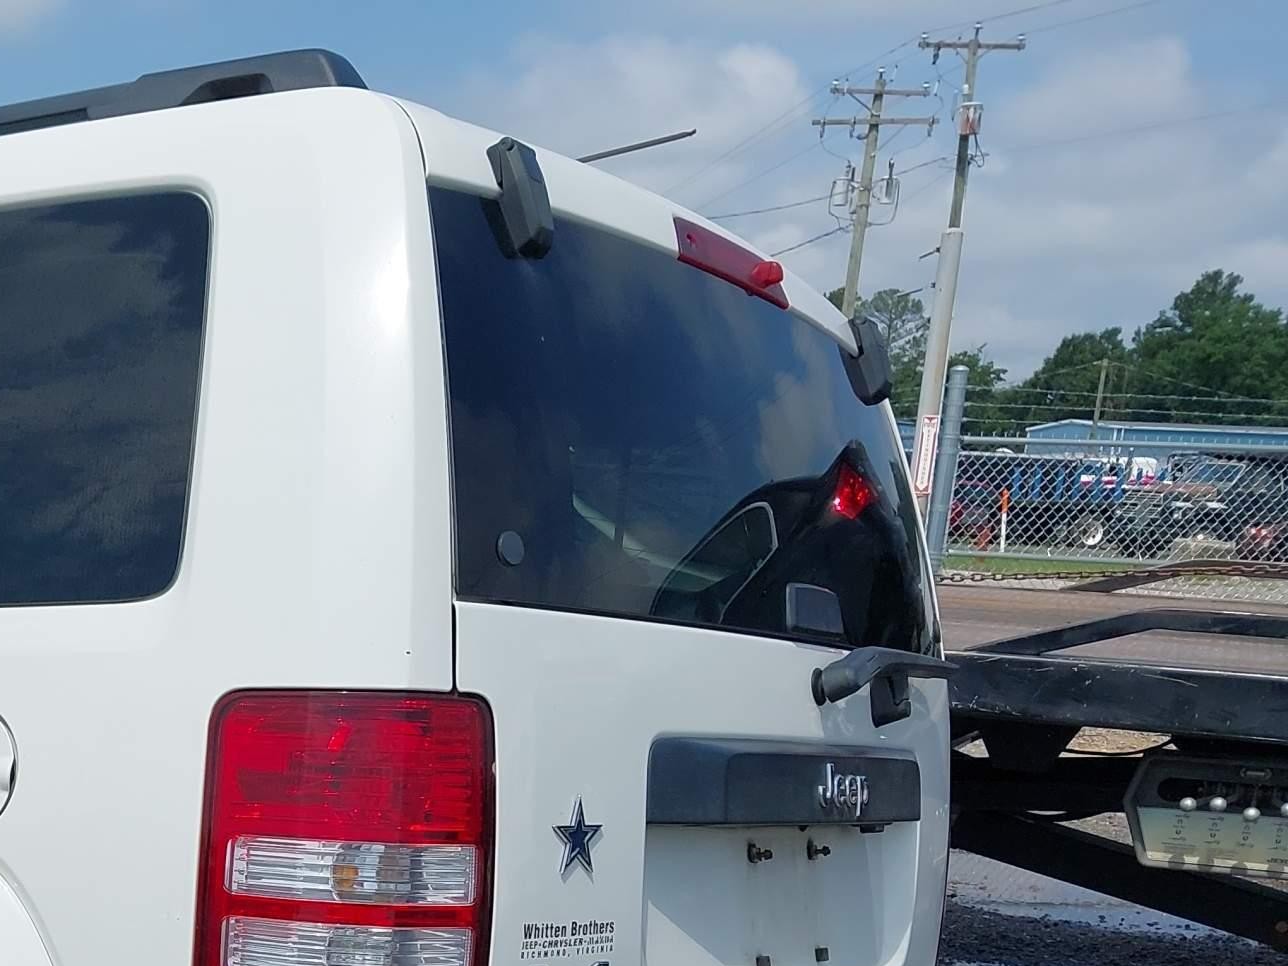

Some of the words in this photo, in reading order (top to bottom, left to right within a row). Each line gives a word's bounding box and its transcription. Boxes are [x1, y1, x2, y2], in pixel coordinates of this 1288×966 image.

[818, 763, 869, 816] Jeep
[523, 923, 567, 940] Whitten
[571, 920, 615, 937] Brothers
[520, 948, 570, 959] RICHMOND,
[576, 944, 613, 955] VIRGINIA
